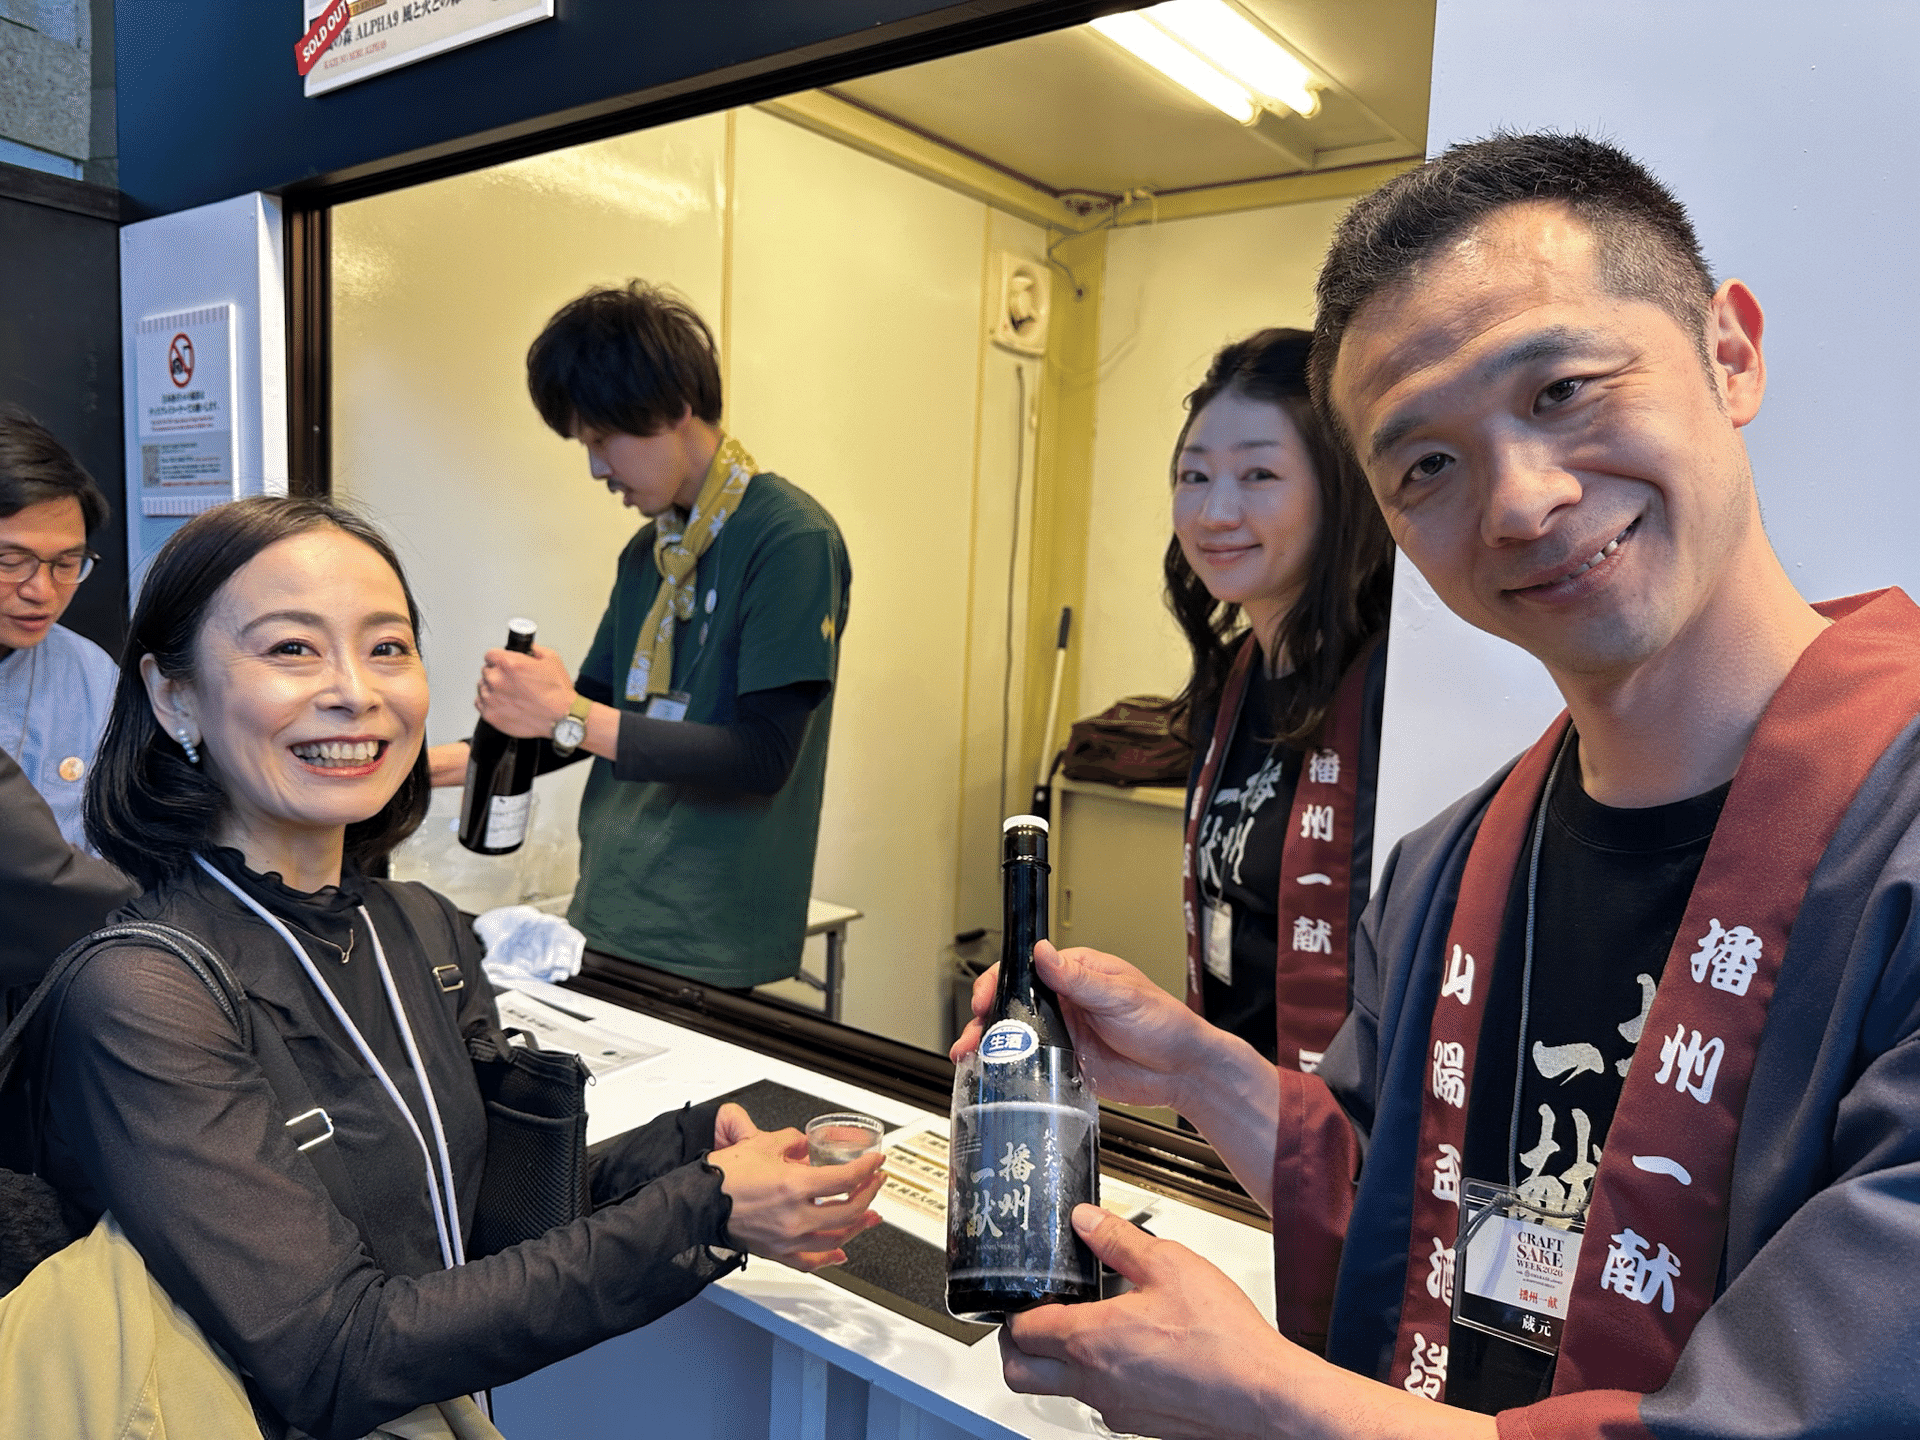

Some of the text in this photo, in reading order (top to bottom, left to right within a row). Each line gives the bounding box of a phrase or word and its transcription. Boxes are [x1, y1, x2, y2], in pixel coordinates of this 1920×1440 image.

[302, 0, 348, 63] SOLD OUT
[356, 10, 399, 41] ALPHA9
[988, 1034, 1024, 1052] 生酒
[1600, 917, 1764, 1314] 播州一献
[998, 1141, 1036, 1231] 播州
[966, 1167, 1004, 1238] 一献
[1517, 1231, 1565, 1252] CRAFT
[1516, 1245, 1564, 1269] SAKE
[1518, 1288, 1559, 1310] 播州一献
[1521, 1314, 1552, 1337] 蔵元
